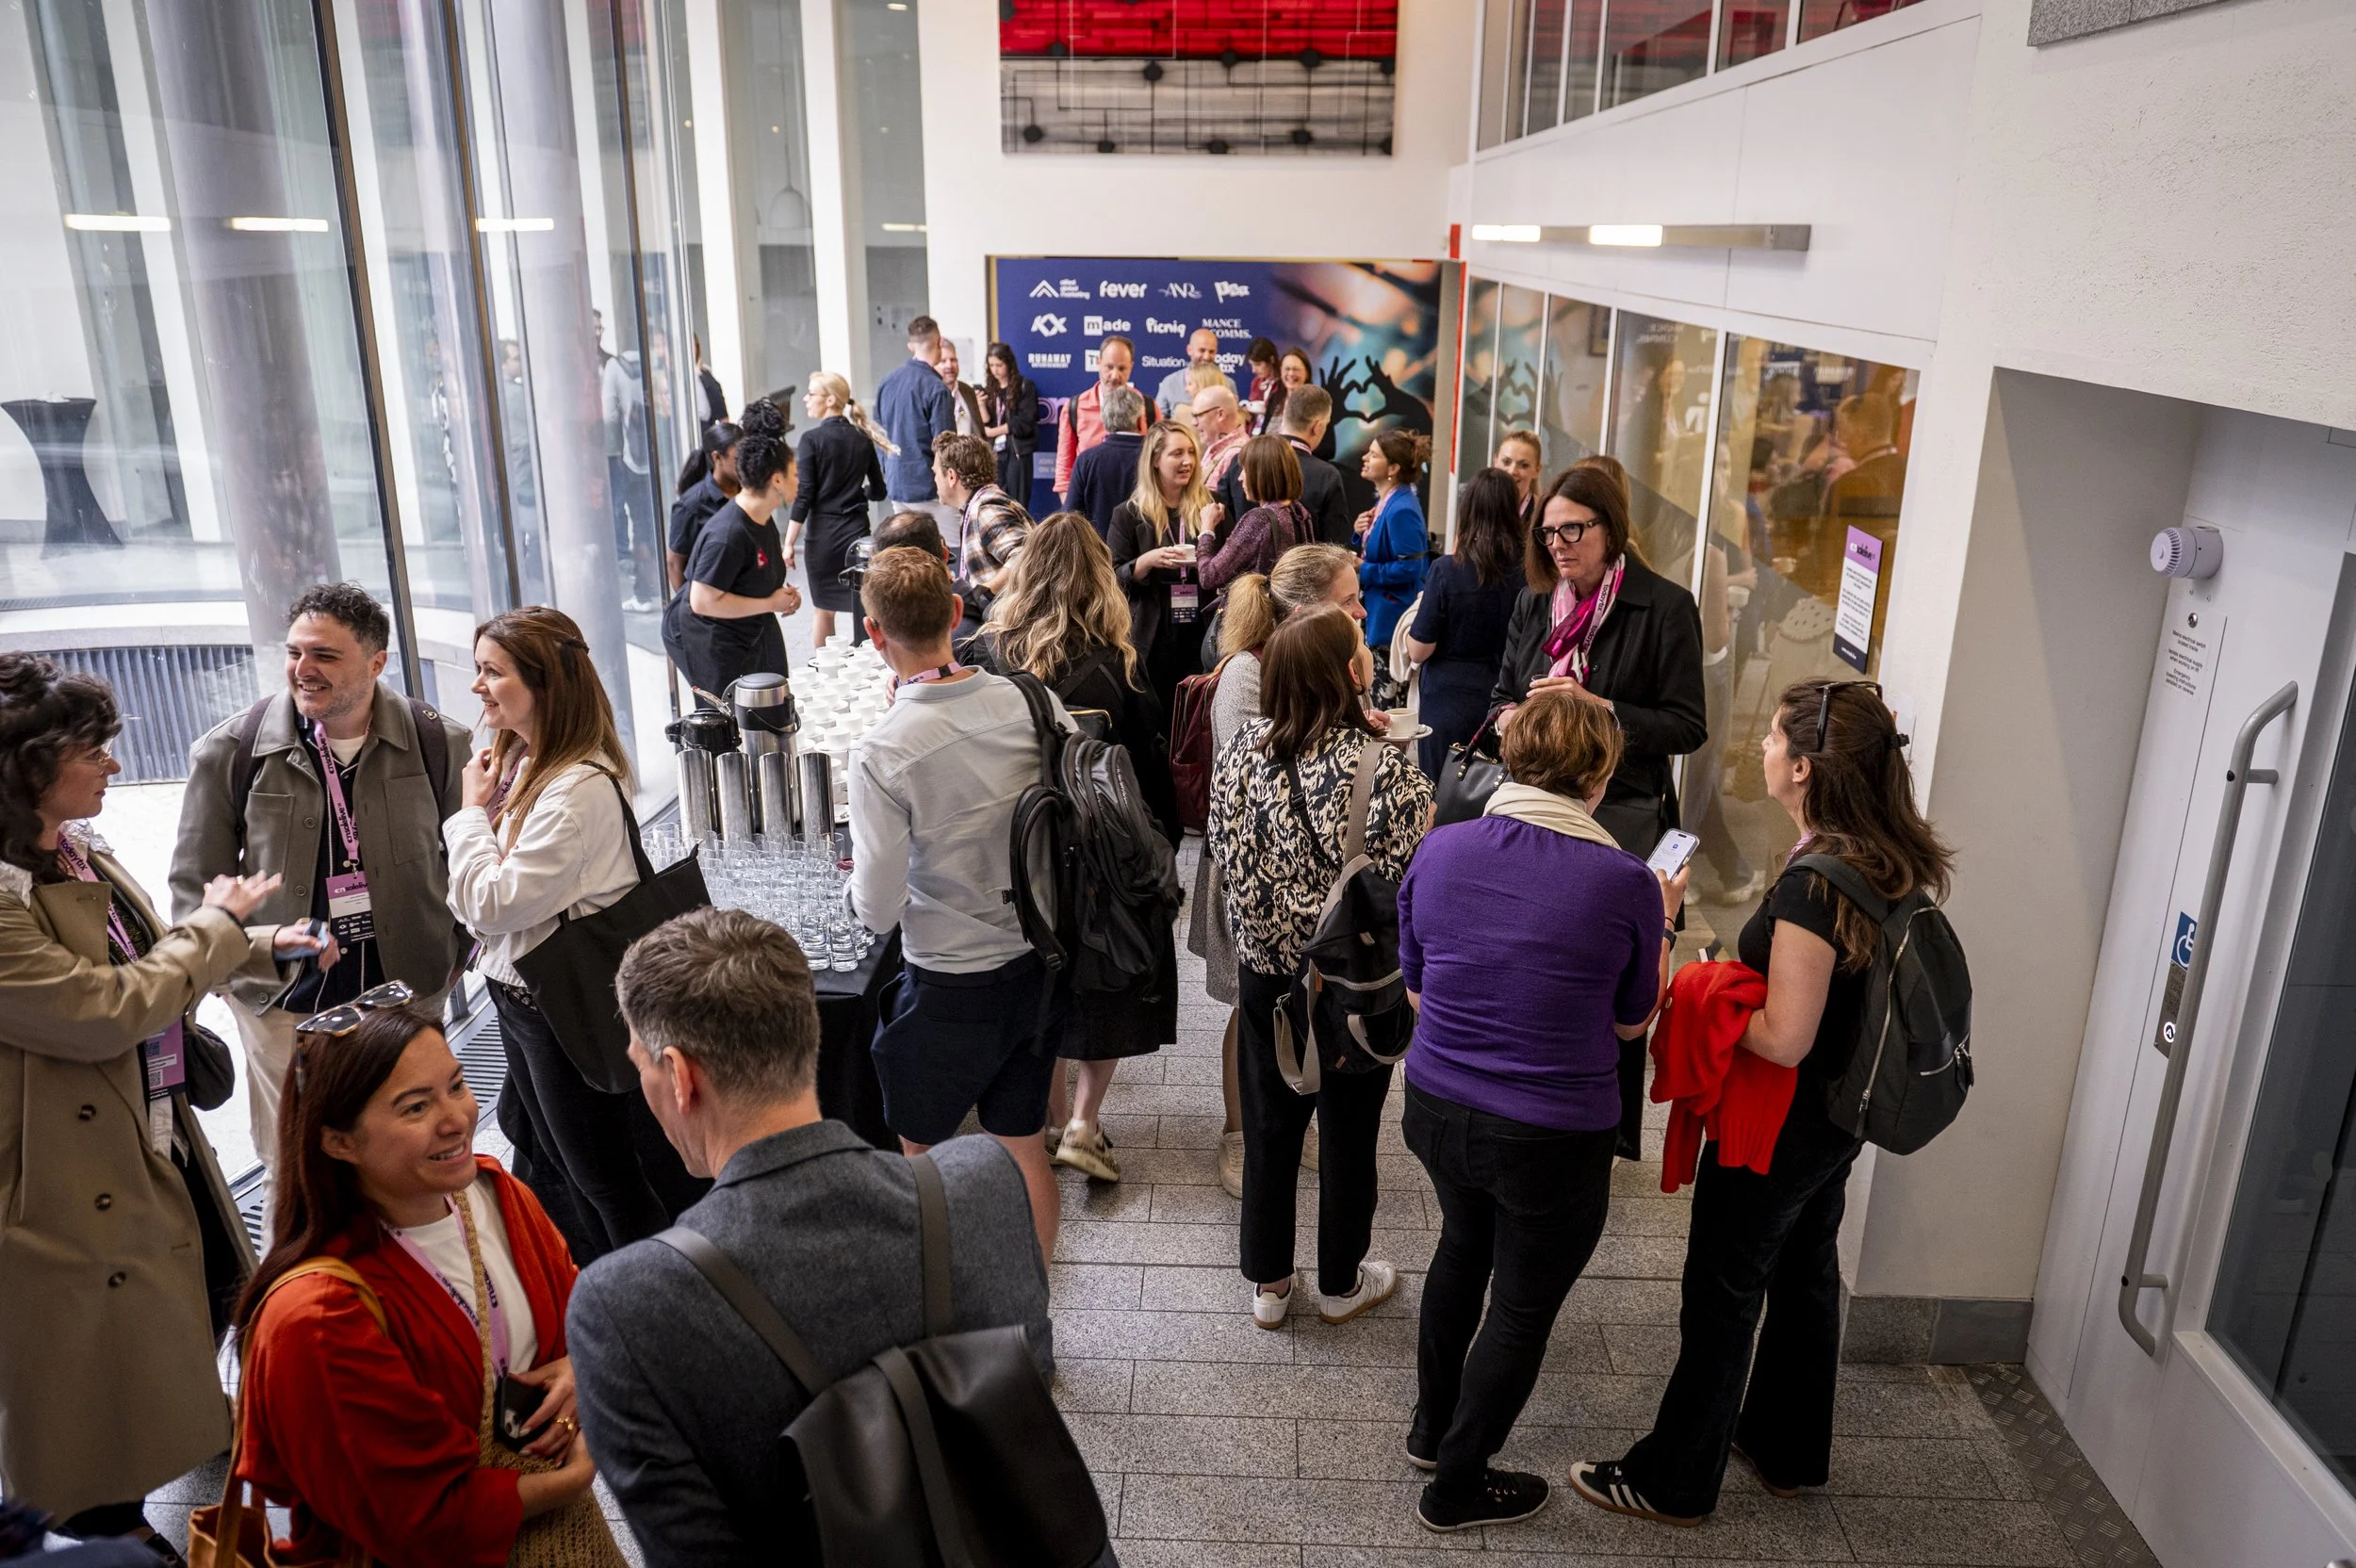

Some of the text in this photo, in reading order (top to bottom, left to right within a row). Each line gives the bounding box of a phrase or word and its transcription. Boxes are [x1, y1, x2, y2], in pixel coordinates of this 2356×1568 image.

[1100, 280, 1147, 298] fever
[1084, 316, 1131, 335] made
[1202, 318, 1241, 329] MANCE
[1028, 353, 1072, 364] RUNAWAY
[1142, 355, 1186, 368] Situation
[1214, 352, 1246, 366] oday
[60, 839, 89, 872] todaytix
